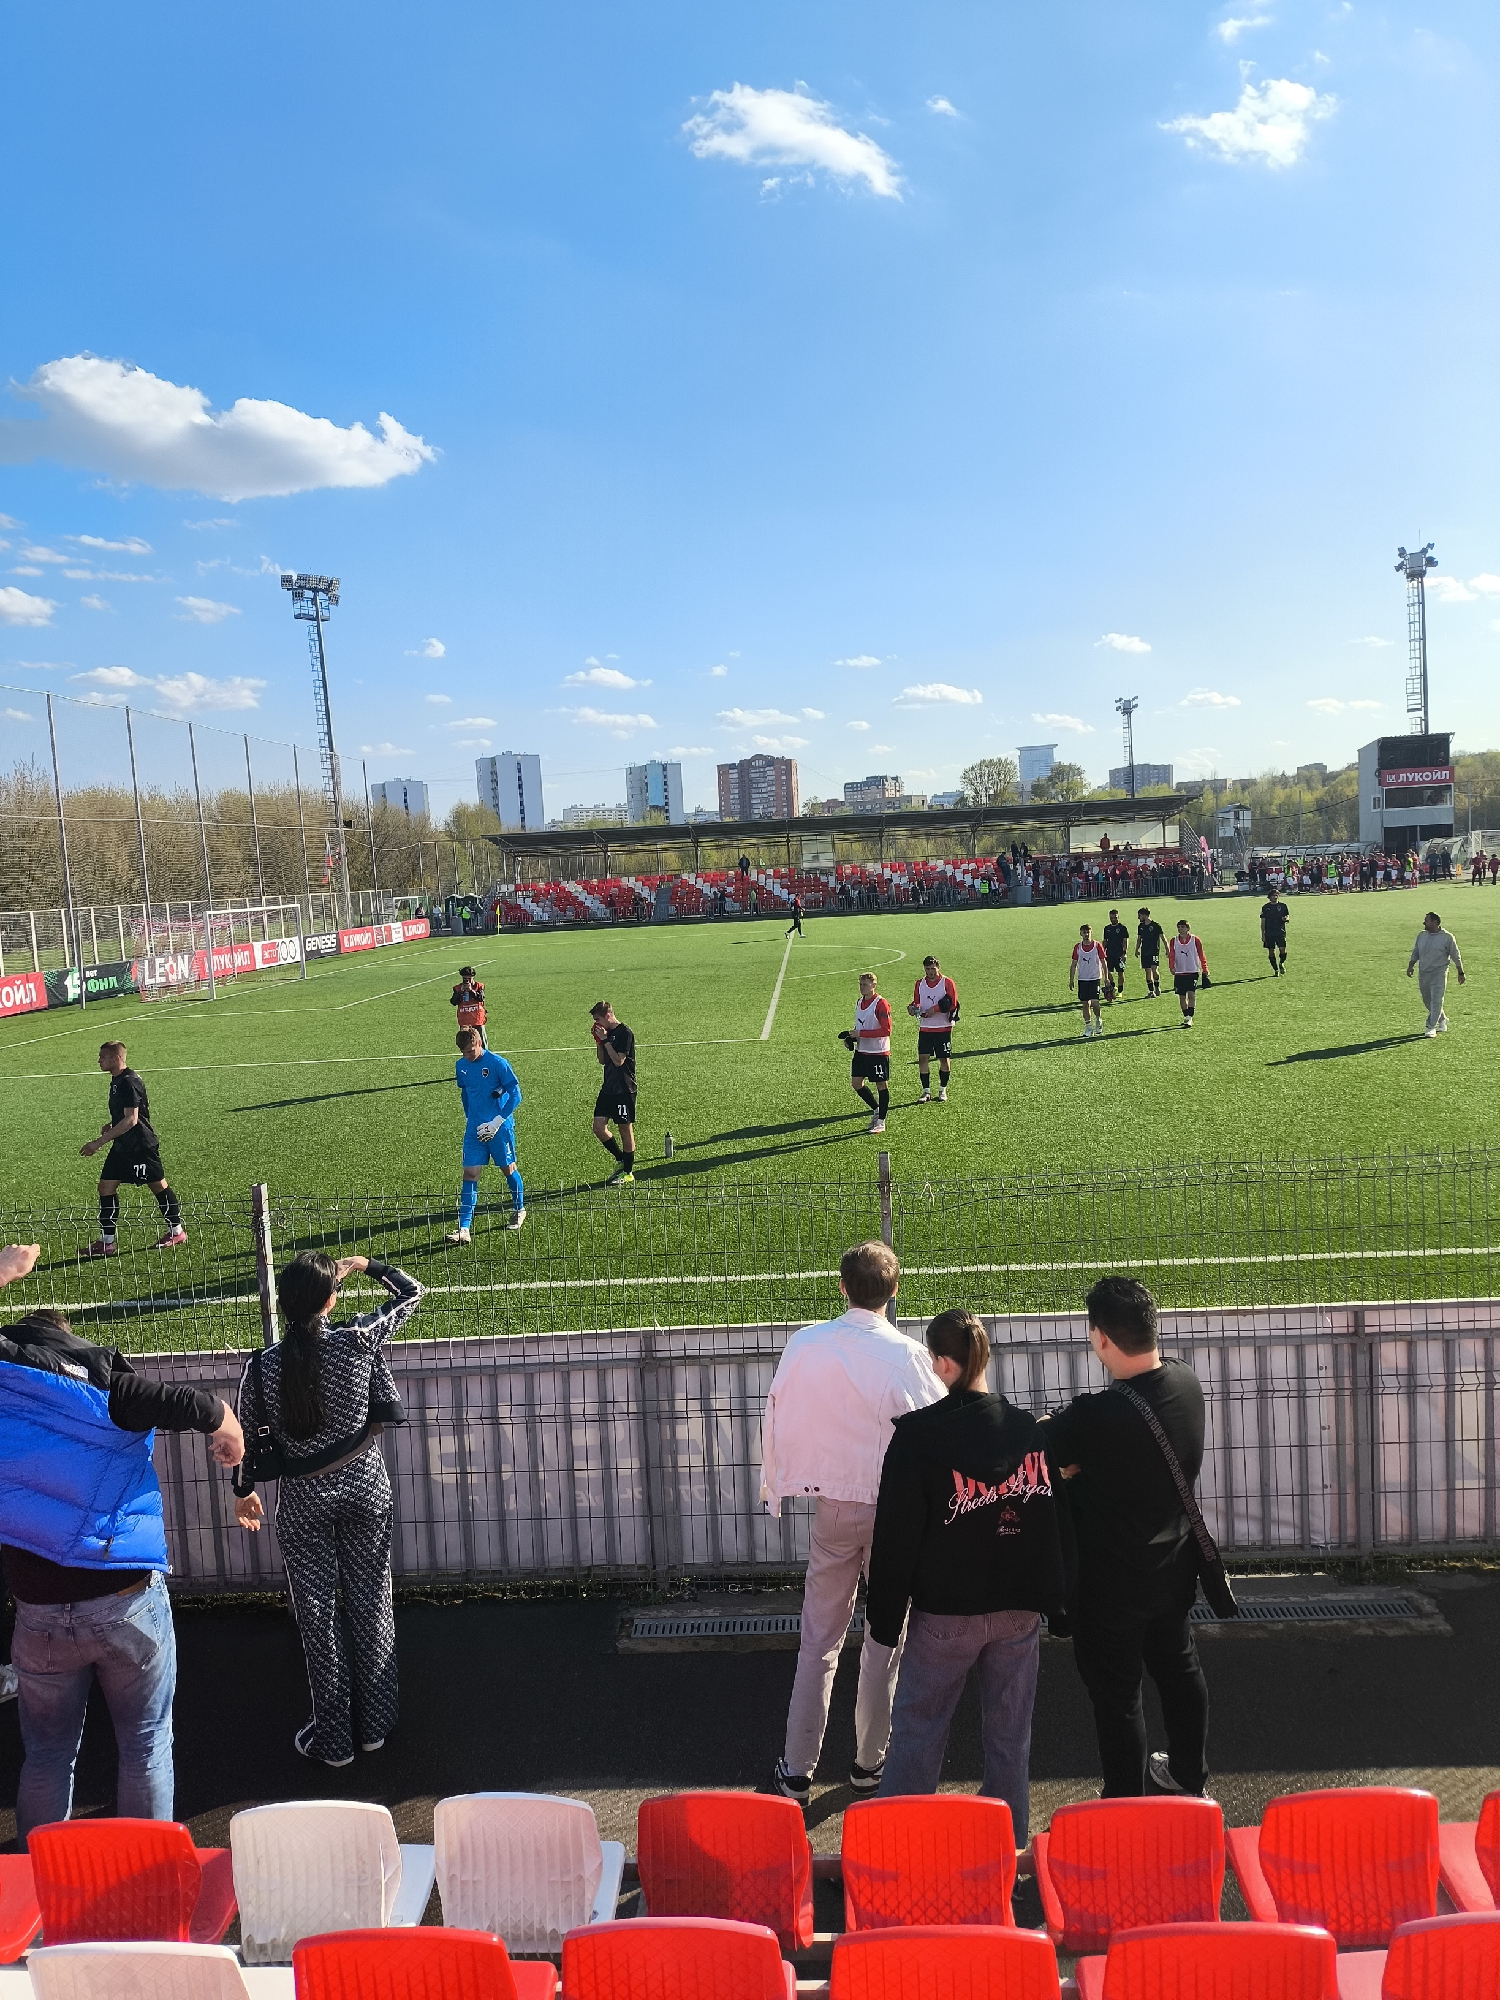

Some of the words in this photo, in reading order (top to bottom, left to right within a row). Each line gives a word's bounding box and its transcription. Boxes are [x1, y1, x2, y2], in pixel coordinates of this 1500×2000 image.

[1398, 770, 1450, 783] ЛУКОЙЛ
[305, 934, 337, 952] GENESIS
[144, 954, 190, 986] LEON
[87, 976, 119, 993] ФНЛ
[0, 979, 37, 1008] ОЙЛ
[874, 1064, 884, 1075] 11
[617, 1104, 628, 1116] 71
[133, 1163, 147, 1178] 77
